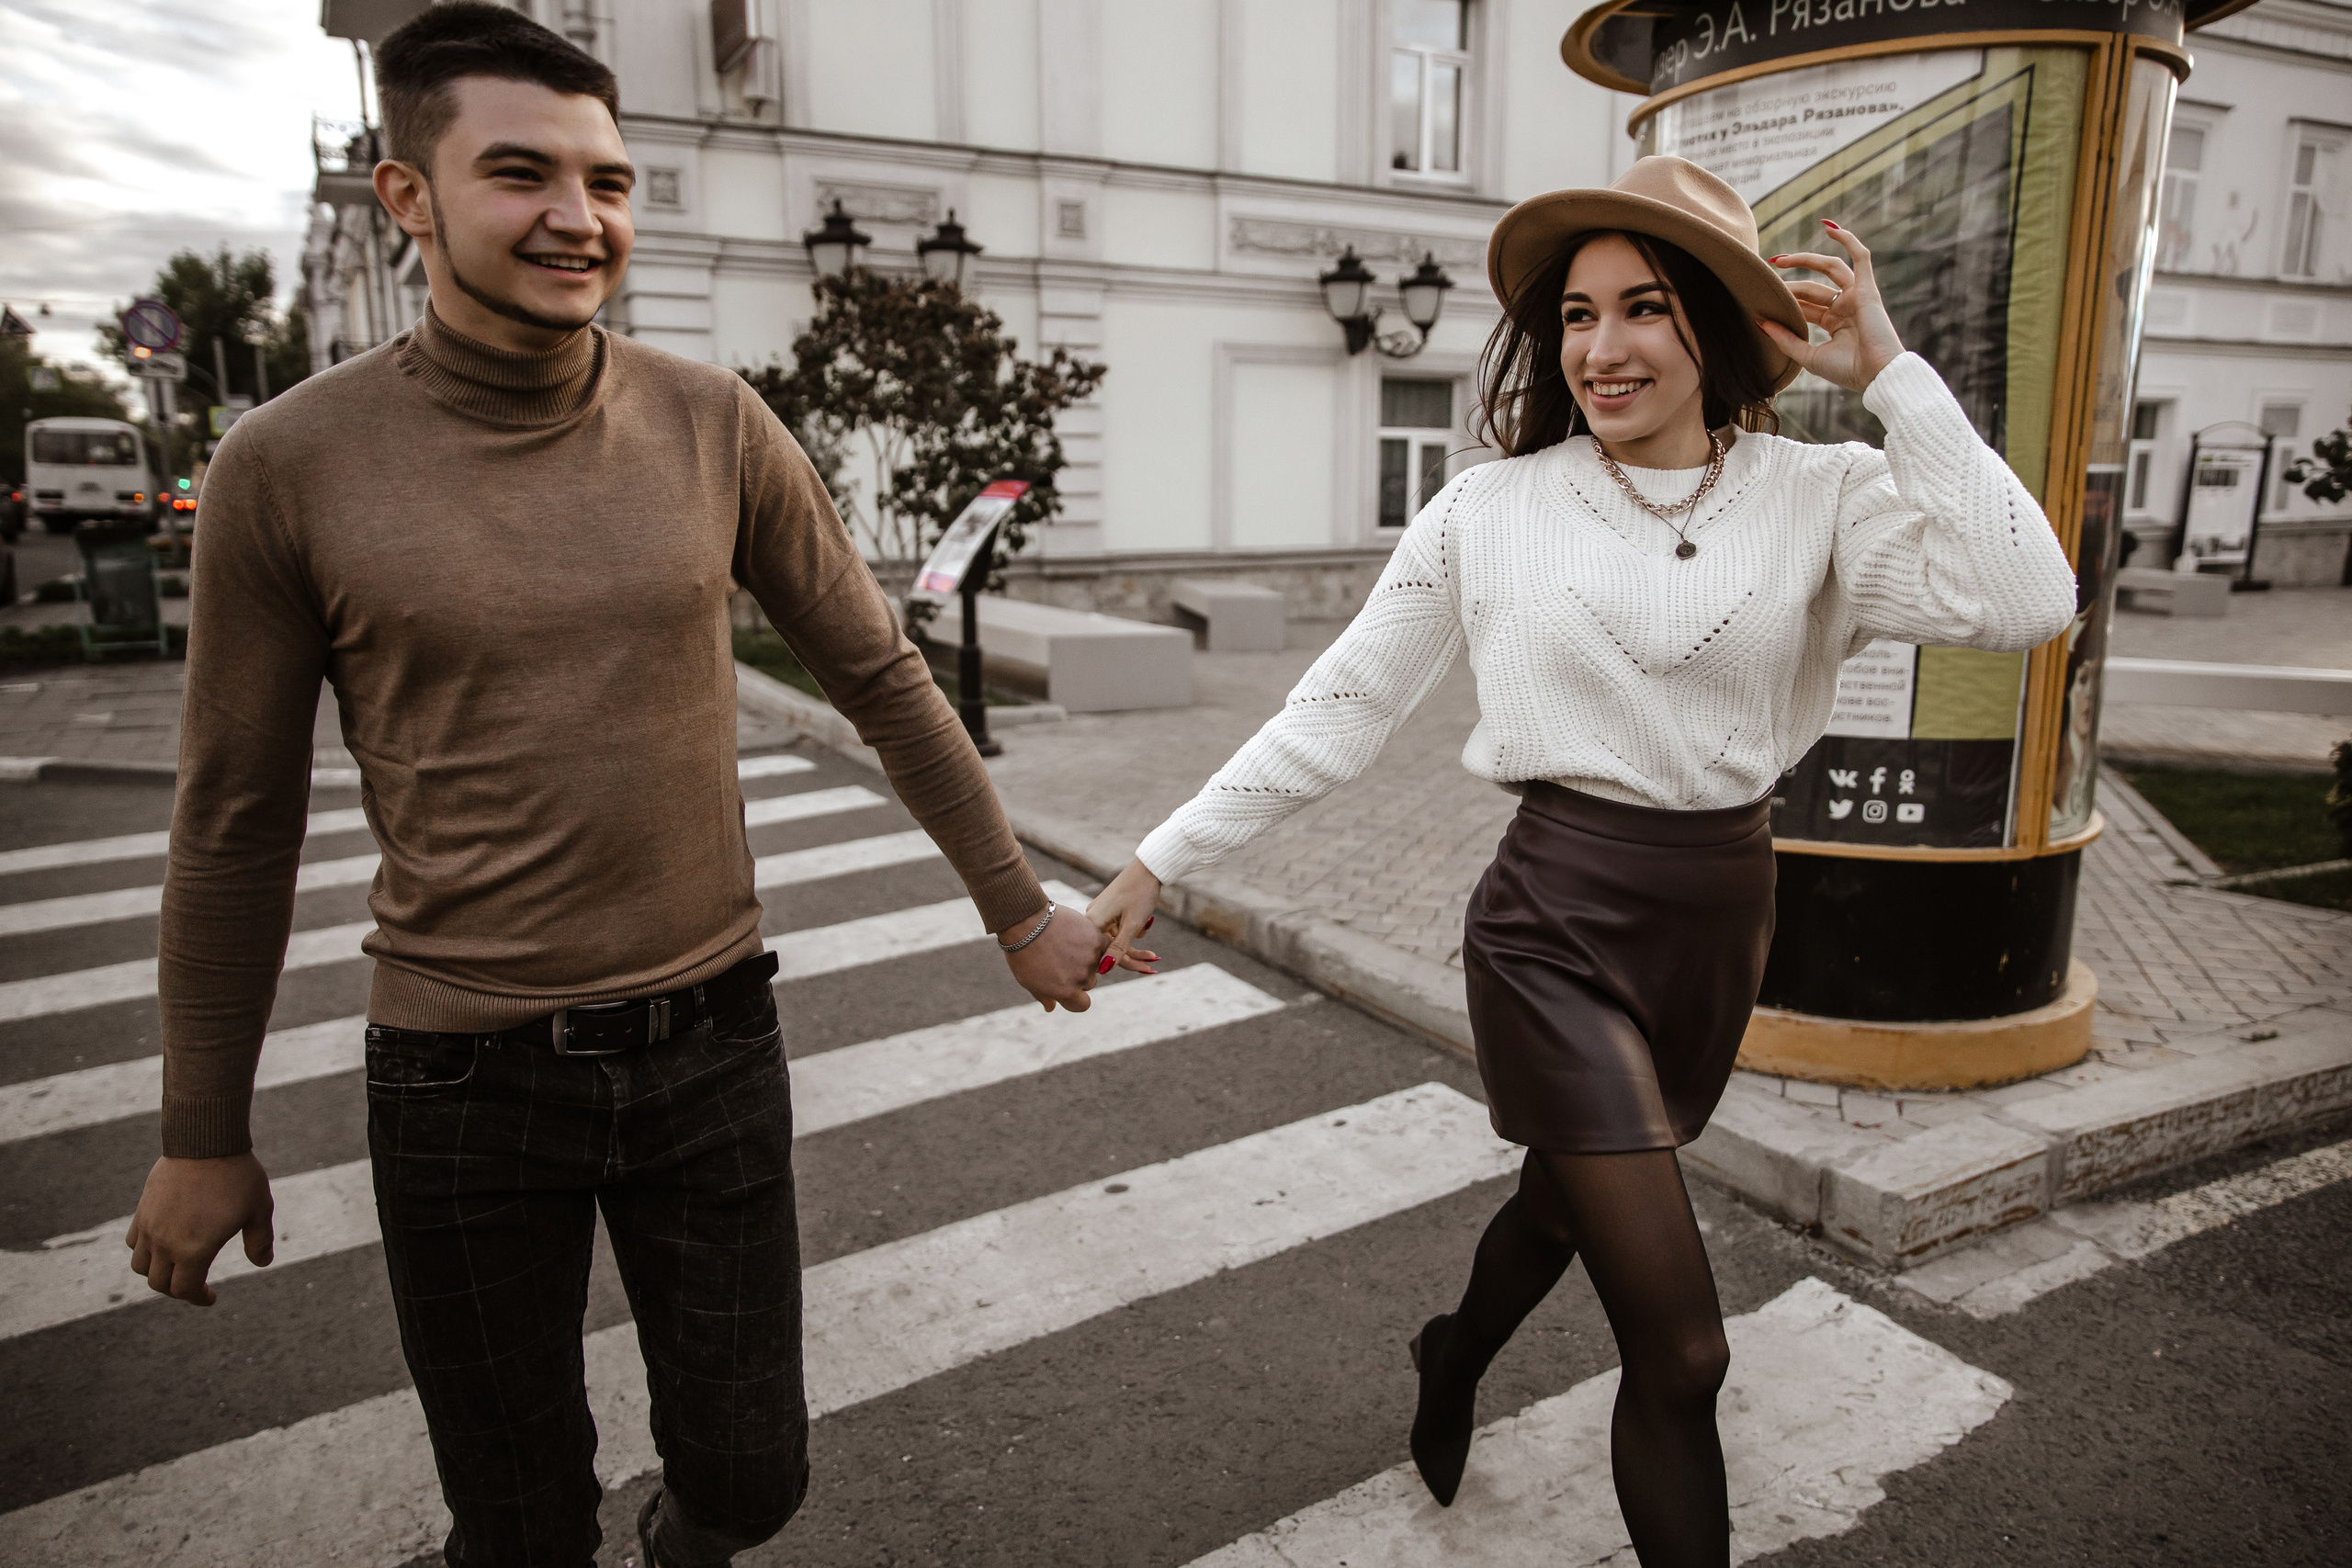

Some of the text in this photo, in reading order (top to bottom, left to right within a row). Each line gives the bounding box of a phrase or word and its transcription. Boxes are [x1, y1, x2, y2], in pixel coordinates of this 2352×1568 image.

[1692, 2, 1758, 61] Э.А.
[1770, 0, 1963, 36] Рязан
[1744, 94, 1811, 115] обзорную
[1814, 81, 1897, 102] экскурсию
[1731, 114, 1797, 135] Эльдара
[1802, 102, 1905, 122] Рязанова».
[1763, 127, 1835, 145] экспозиции
[1731, 146, 1817, 168] мемориальная
[1843, 661, 1877, 674] обое
[1839, 680, 1905, 692] ественной
